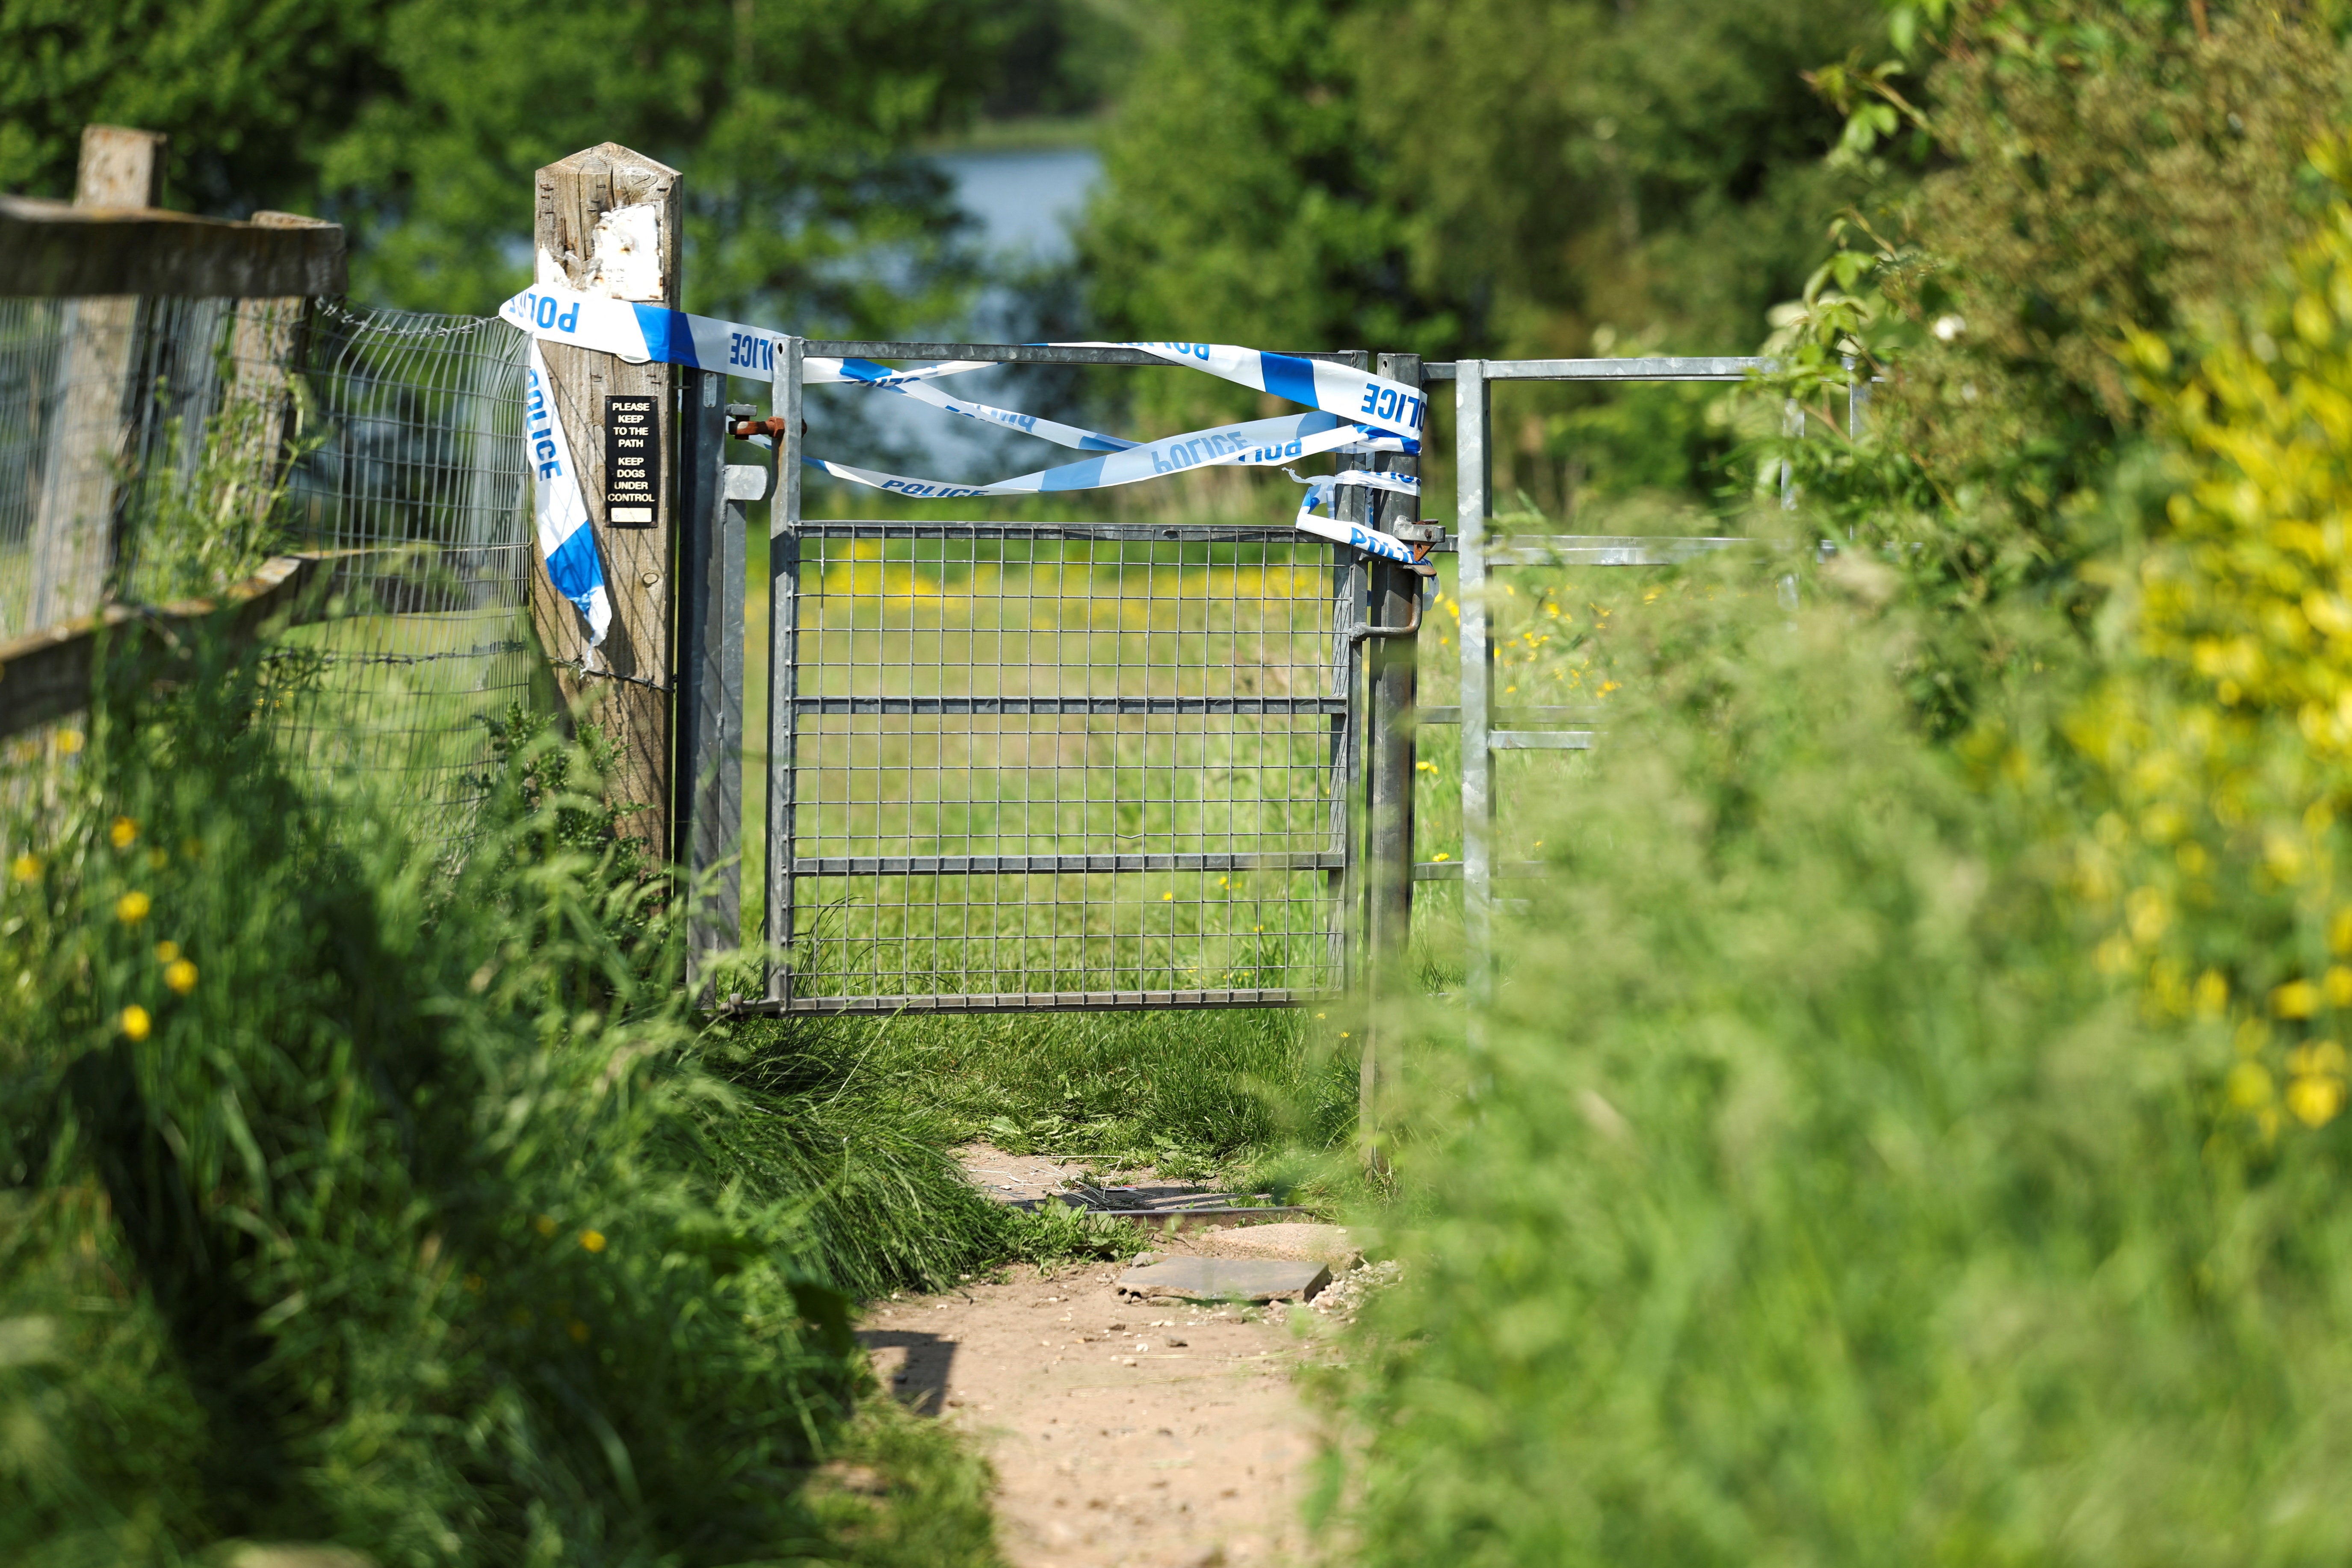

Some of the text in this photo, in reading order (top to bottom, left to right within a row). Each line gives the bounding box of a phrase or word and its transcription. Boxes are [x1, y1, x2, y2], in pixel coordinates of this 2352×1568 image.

[730, 333, 773, 371] LICE
[612, 403, 650, 411] PLEASE
[1361, 383, 1427, 432] OLICE
[618, 415, 644, 423] KEEP
[613, 427, 649, 435] TO THE
[618, 439, 644, 447] PATH
[618, 457, 644, 466] KEEP
[617, 470, 646, 478] DOGS
[614, 481, 648, 490] UNDER
[881, 479, 990, 497] POLICE
[608, 493, 656, 502] CONTROL
